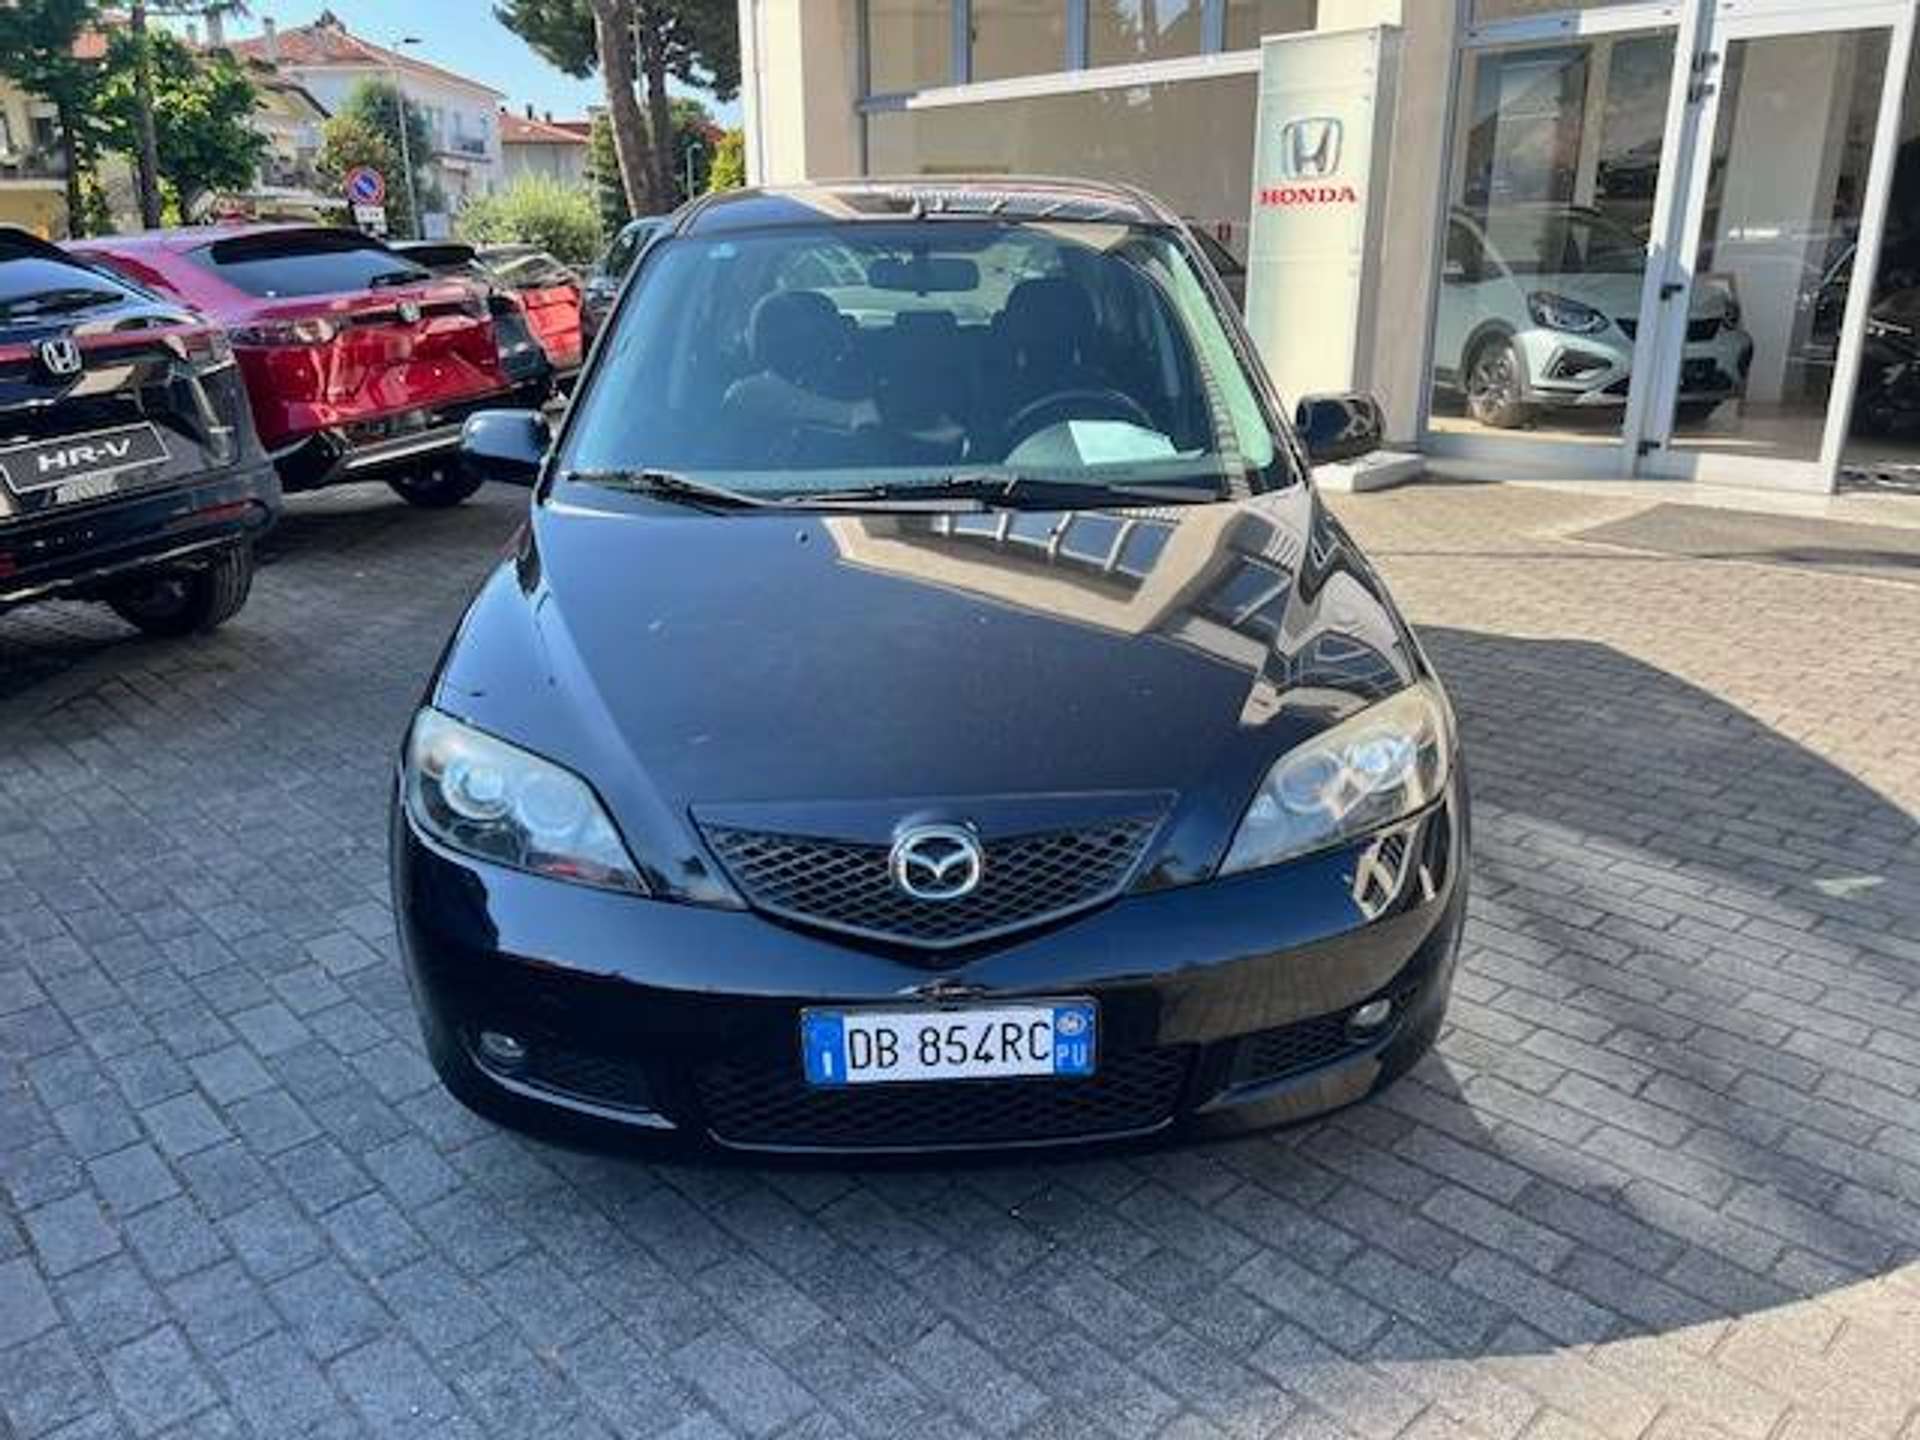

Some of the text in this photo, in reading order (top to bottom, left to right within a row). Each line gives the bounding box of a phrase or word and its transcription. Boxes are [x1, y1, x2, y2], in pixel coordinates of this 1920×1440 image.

[1260, 187, 1356, 205] HONDA
[38, 440, 130, 471] HR-V
[848, 1028, 899, 1070] DB
[919, 1022, 1052, 1066] 854RC
